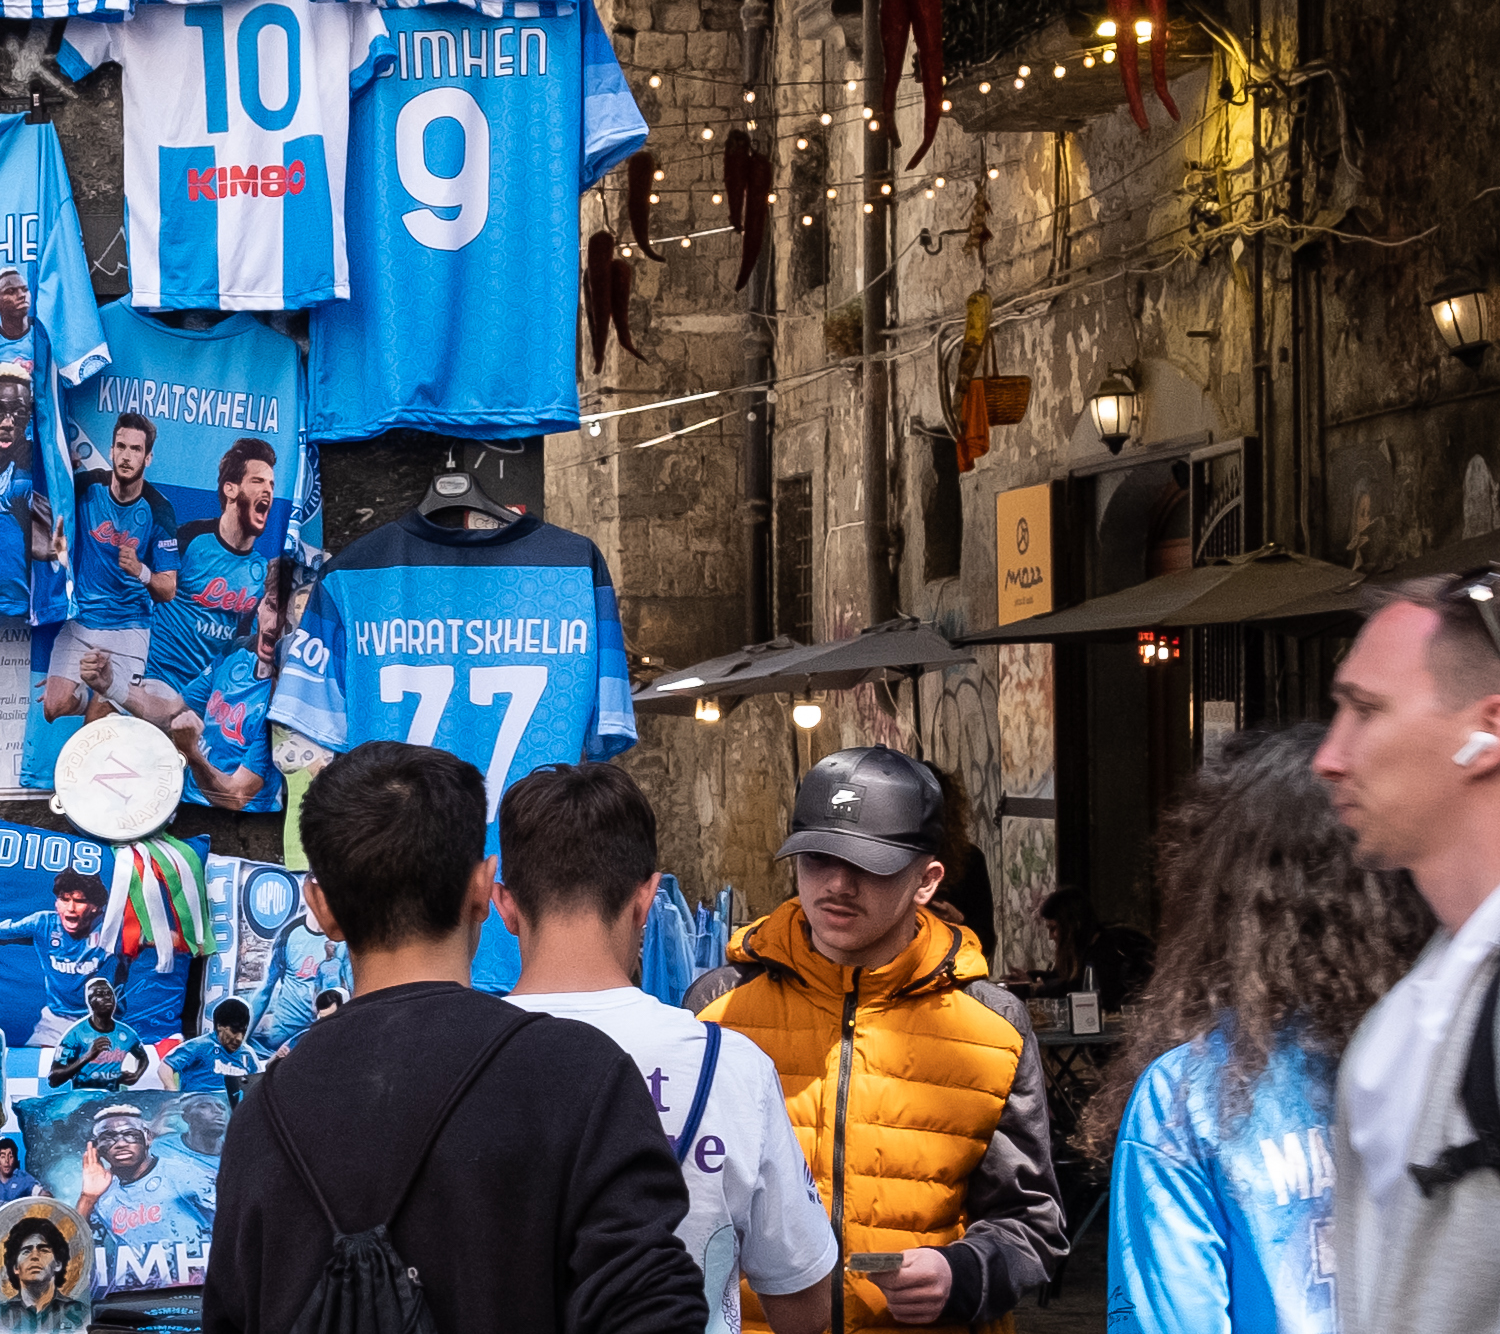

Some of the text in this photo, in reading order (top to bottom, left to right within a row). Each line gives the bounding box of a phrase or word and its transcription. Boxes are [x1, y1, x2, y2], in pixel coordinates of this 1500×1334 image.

[184, 2, 301, 135] 10
[395, 85, 491, 252] 9
[98, 375, 279, 434] KVARATSKHELIA
[355, 618, 588, 657] KVARATSKHELIA
[63, 725, 120, 785] FORZA
[379, 664, 549, 789] 77
[116, 764, 173, 832] NAPOLI
